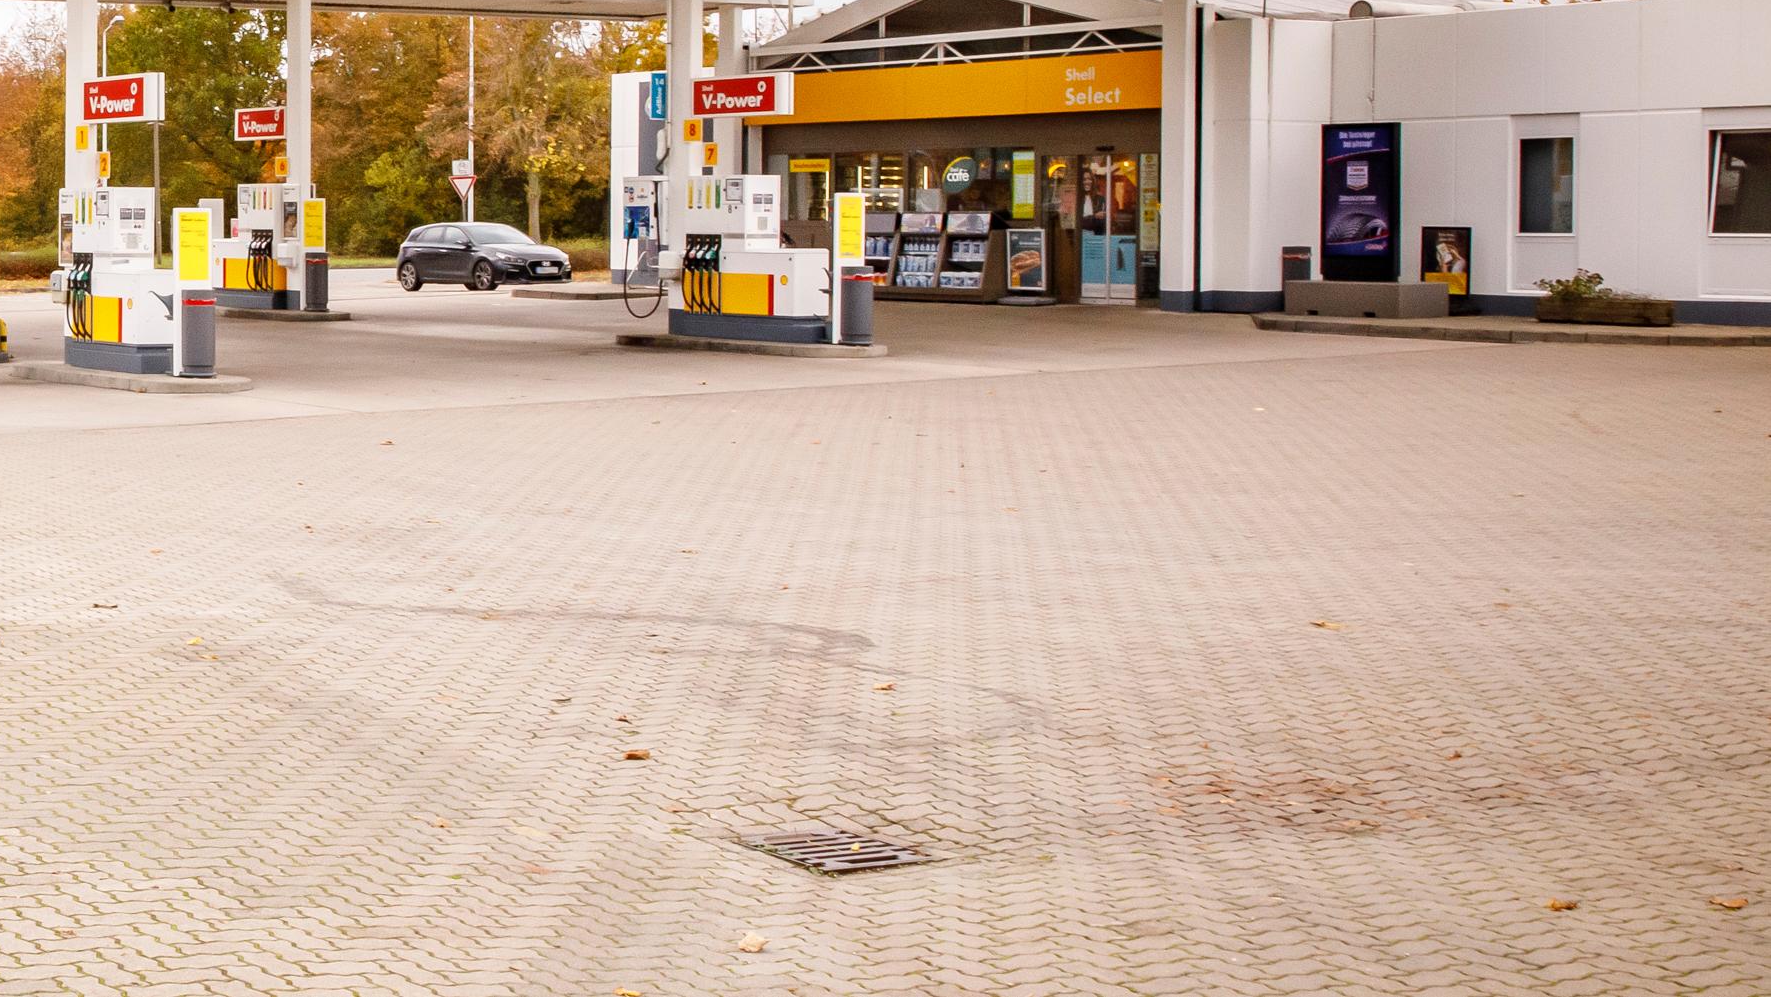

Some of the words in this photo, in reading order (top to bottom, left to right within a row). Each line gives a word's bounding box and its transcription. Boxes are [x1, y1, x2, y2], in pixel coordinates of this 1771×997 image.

[1065, 66, 1095, 81] Shell
[701, 93, 763, 110] V-Power
[1065, 85, 1121, 106] Select
[89, 95, 135, 114] V-Power
[242, 121, 278, 134] V-Power
[689, 123, 696, 137] 8
[707, 148, 715, 161] 7
